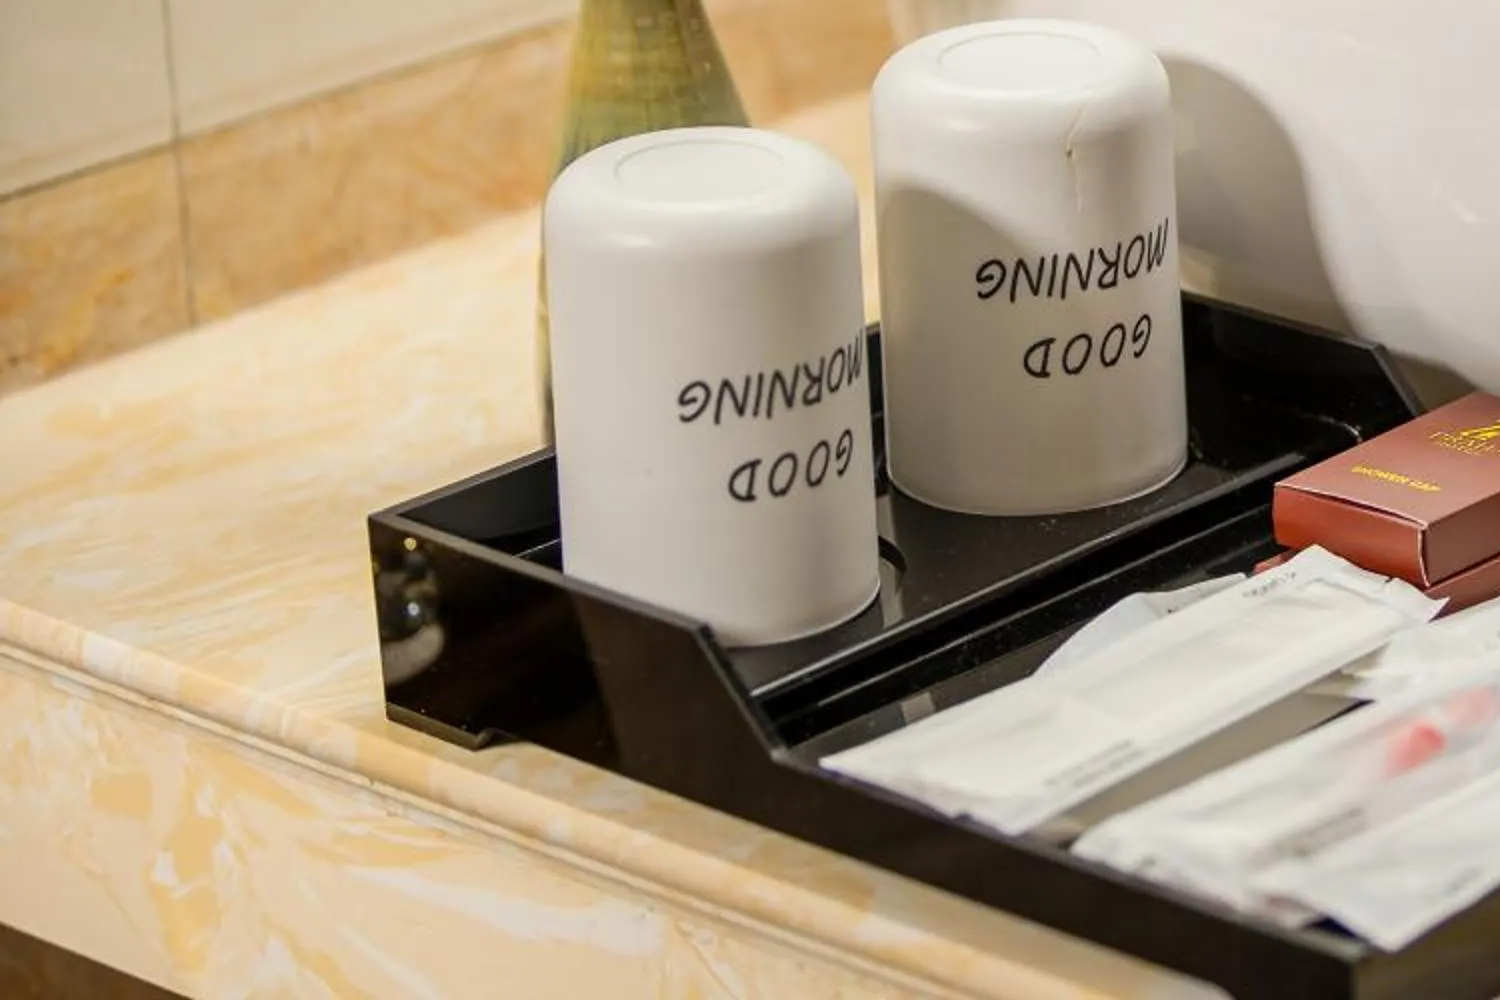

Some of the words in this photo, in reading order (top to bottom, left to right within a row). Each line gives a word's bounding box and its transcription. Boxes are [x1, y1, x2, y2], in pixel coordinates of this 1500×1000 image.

[974, 217, 1169, 303] MORNING
[677, 328, 864, 425] MORNING
[1023, 313, 1152, 379] GOOD
[728, 429, 853, 502] GOOD
